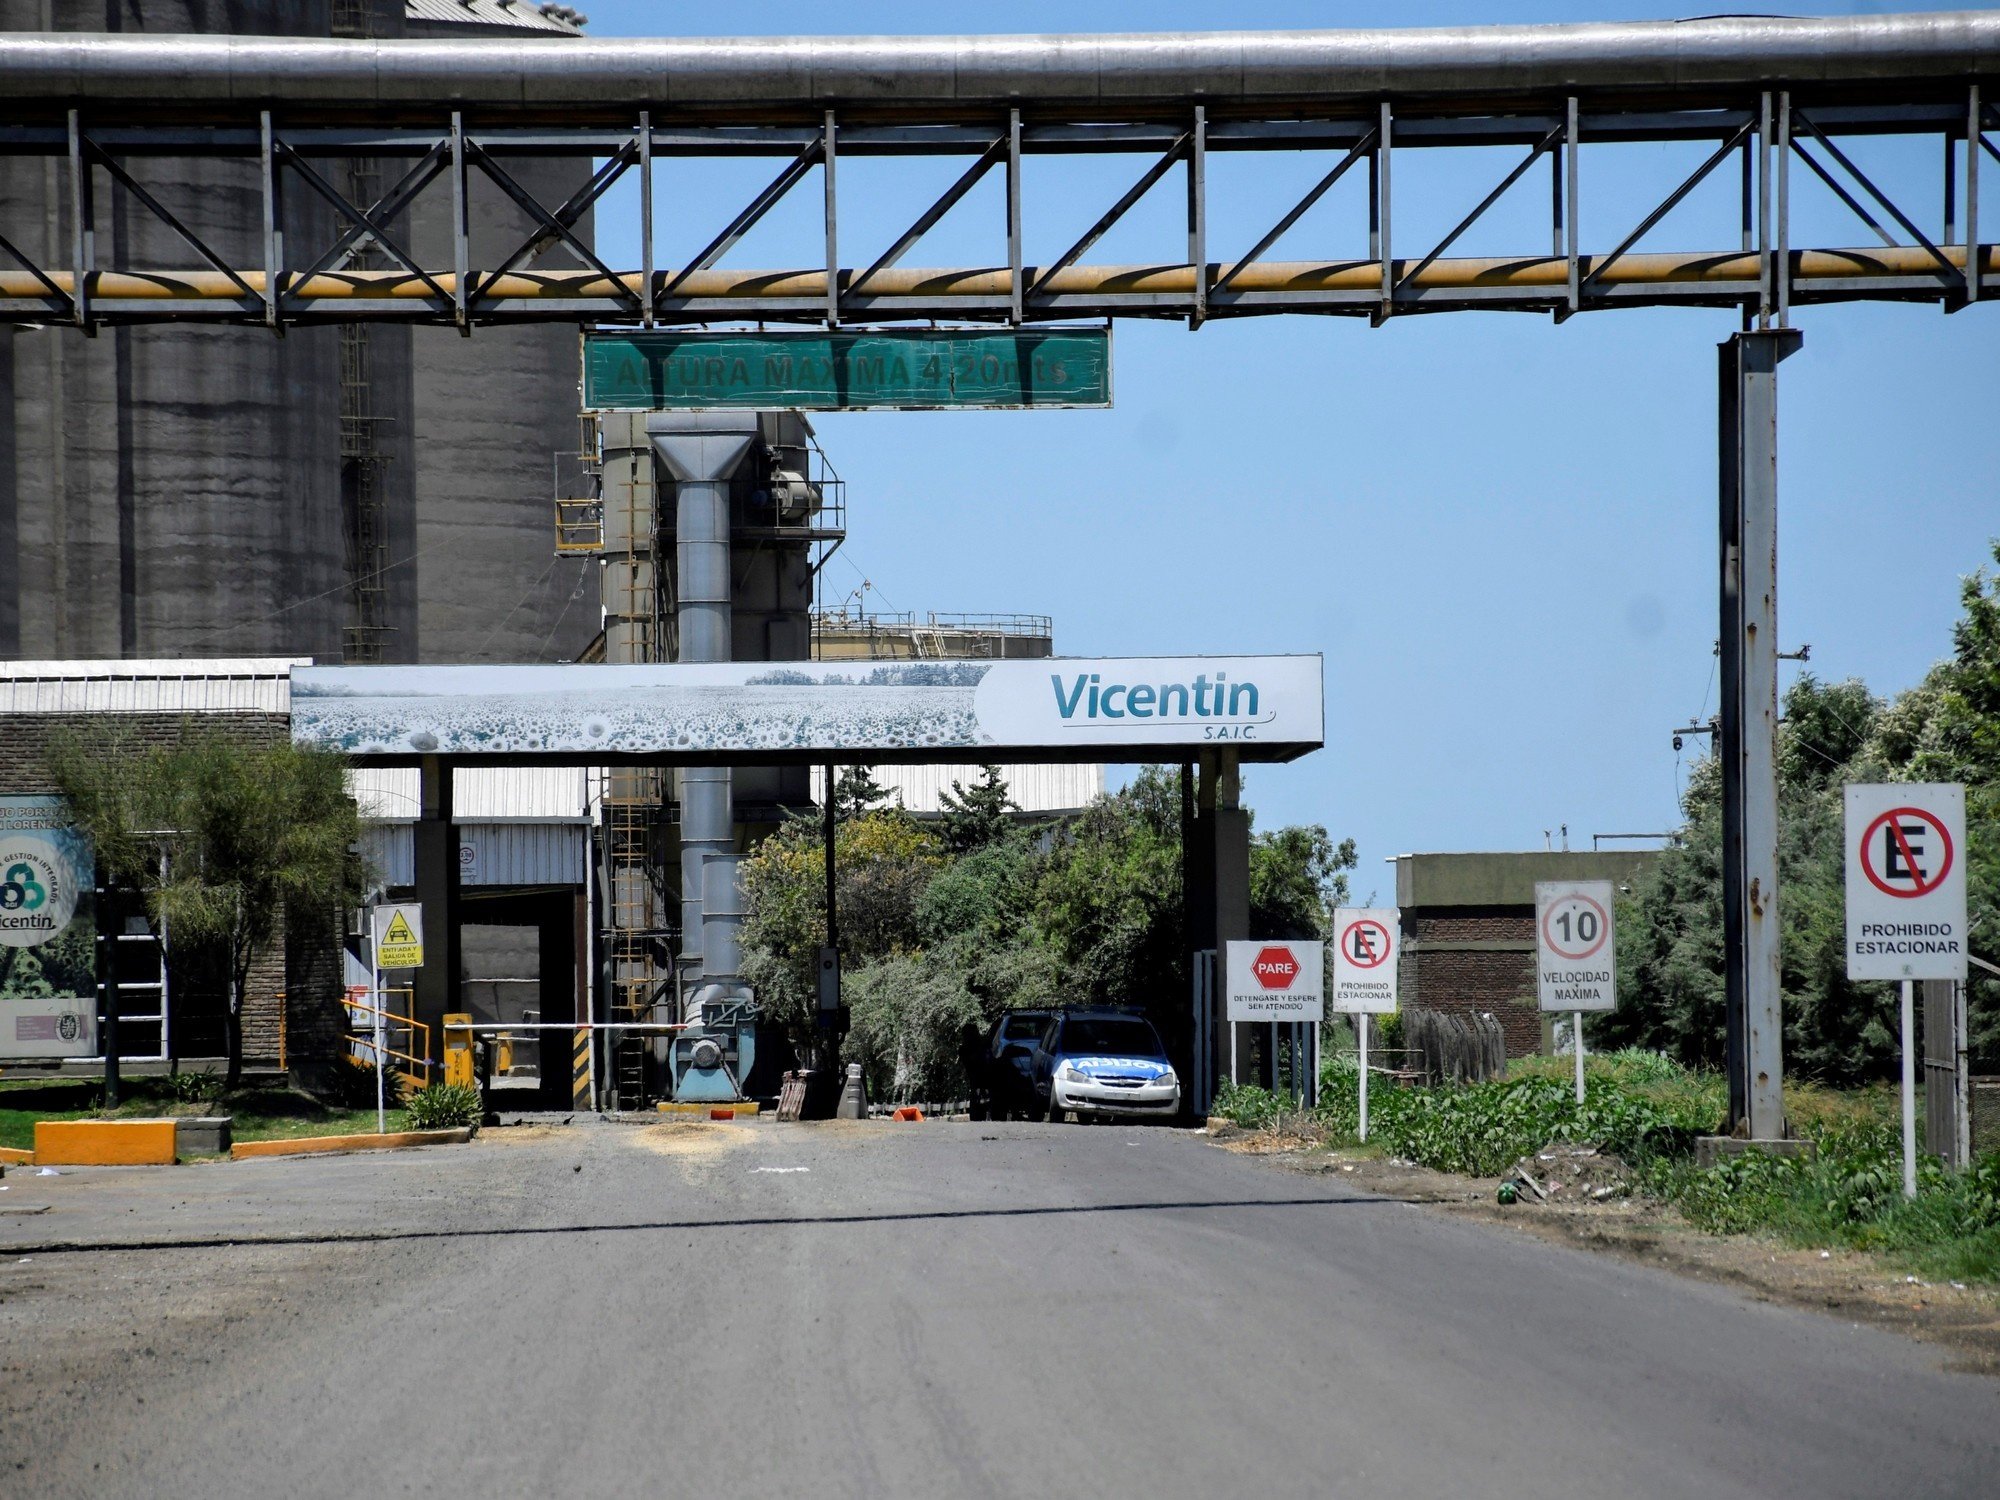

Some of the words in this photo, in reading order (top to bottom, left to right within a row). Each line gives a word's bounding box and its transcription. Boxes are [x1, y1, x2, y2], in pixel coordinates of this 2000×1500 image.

[1051, 671, 1259, 719] Vicentin
[1203, 725, 1257, 740] S.A.I.C.
[1556, 911, 1598, 942] 10
[1861, 923, 1952, 937] PROHIBIDO
[1855, 941, 1960, 955] ESTACIONAR
[1258, 963, 1294, 975] PARE
[1543, 971, 1611, 984] VELOCIDAD
[1341, 982, 1389, 990] PROHIBIDO
[1337, 991, 1393, 1000] ESTACIONAR
[1554, 988, 1601, 1001] MAXIMA
